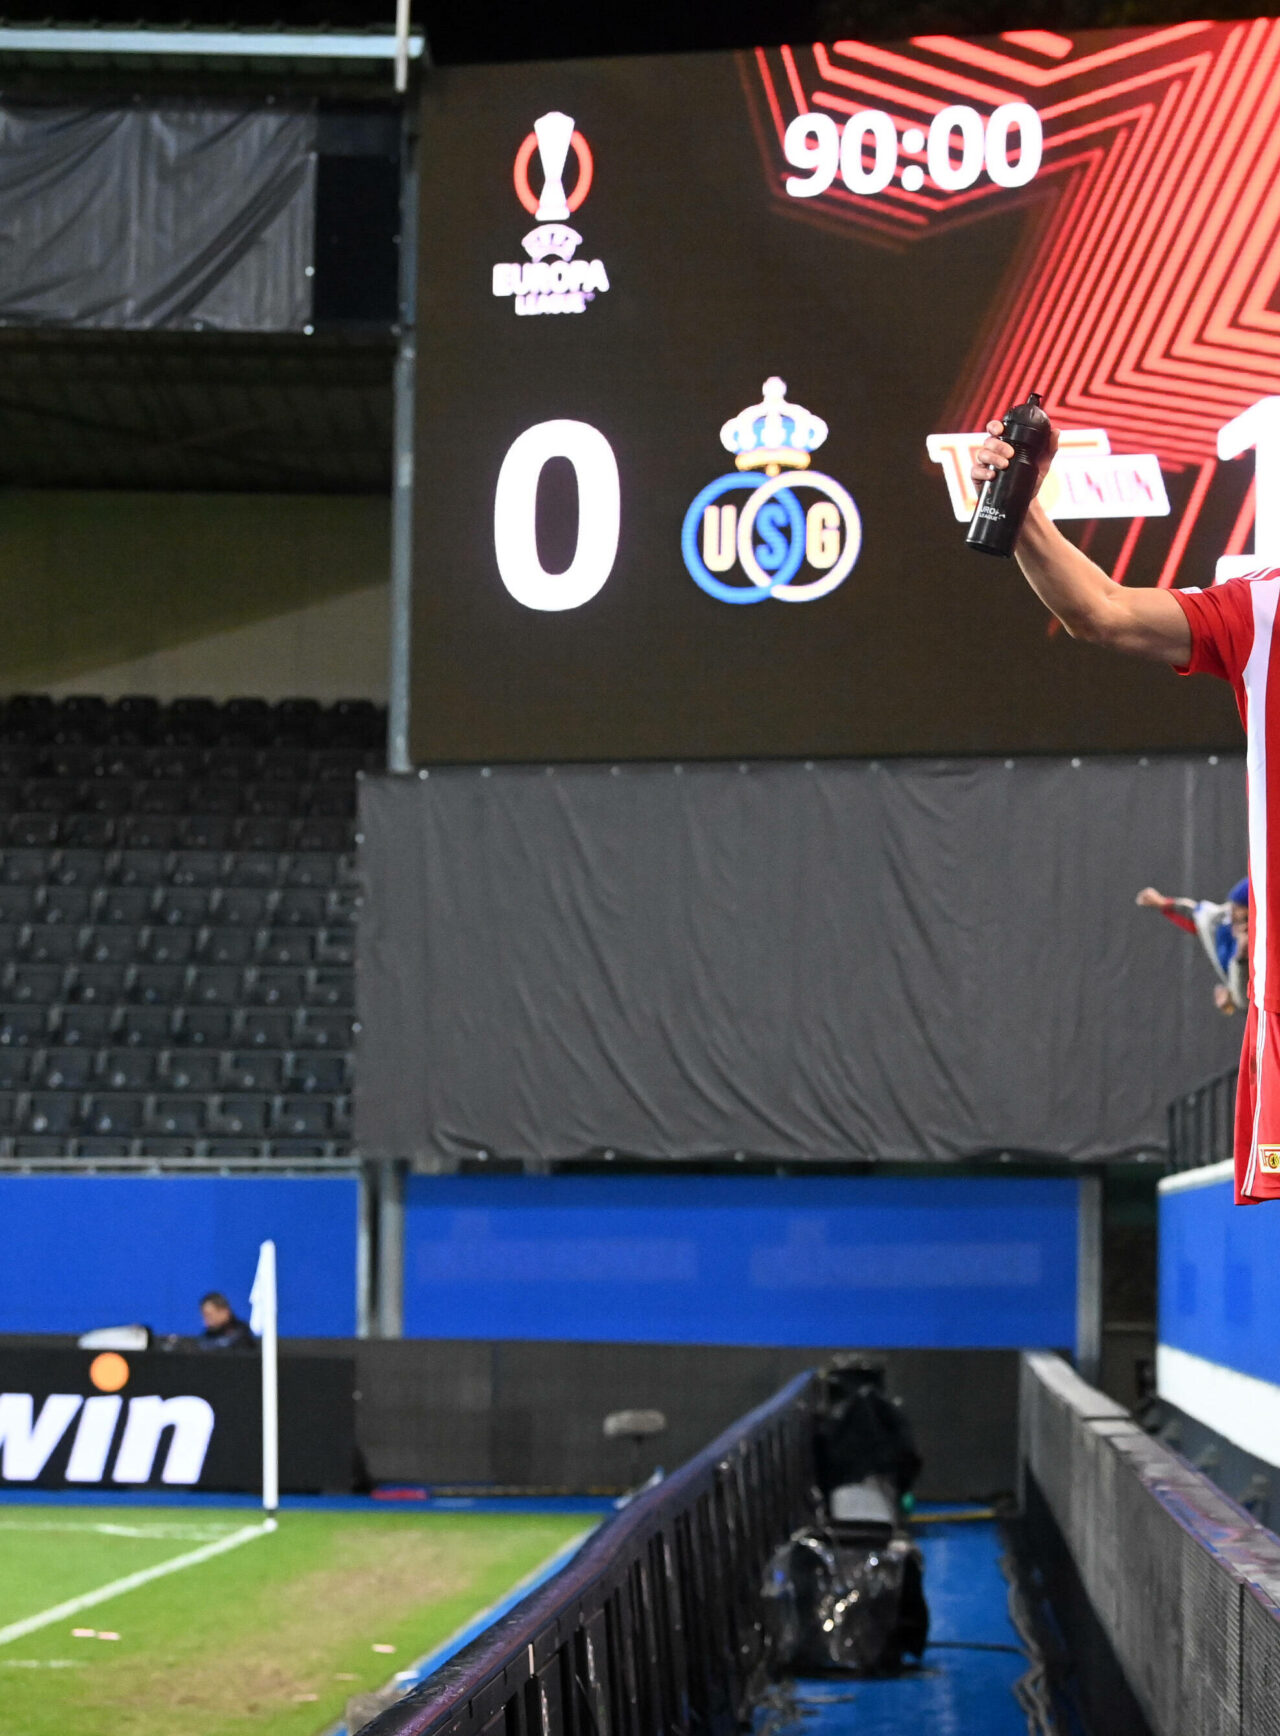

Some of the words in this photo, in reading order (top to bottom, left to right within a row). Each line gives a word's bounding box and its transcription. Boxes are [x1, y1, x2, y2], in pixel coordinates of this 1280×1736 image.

[784, 102, 1043, 198] 90:00
[494, 419, 621, 612] 0
[703, 502, 840, 571] USG
